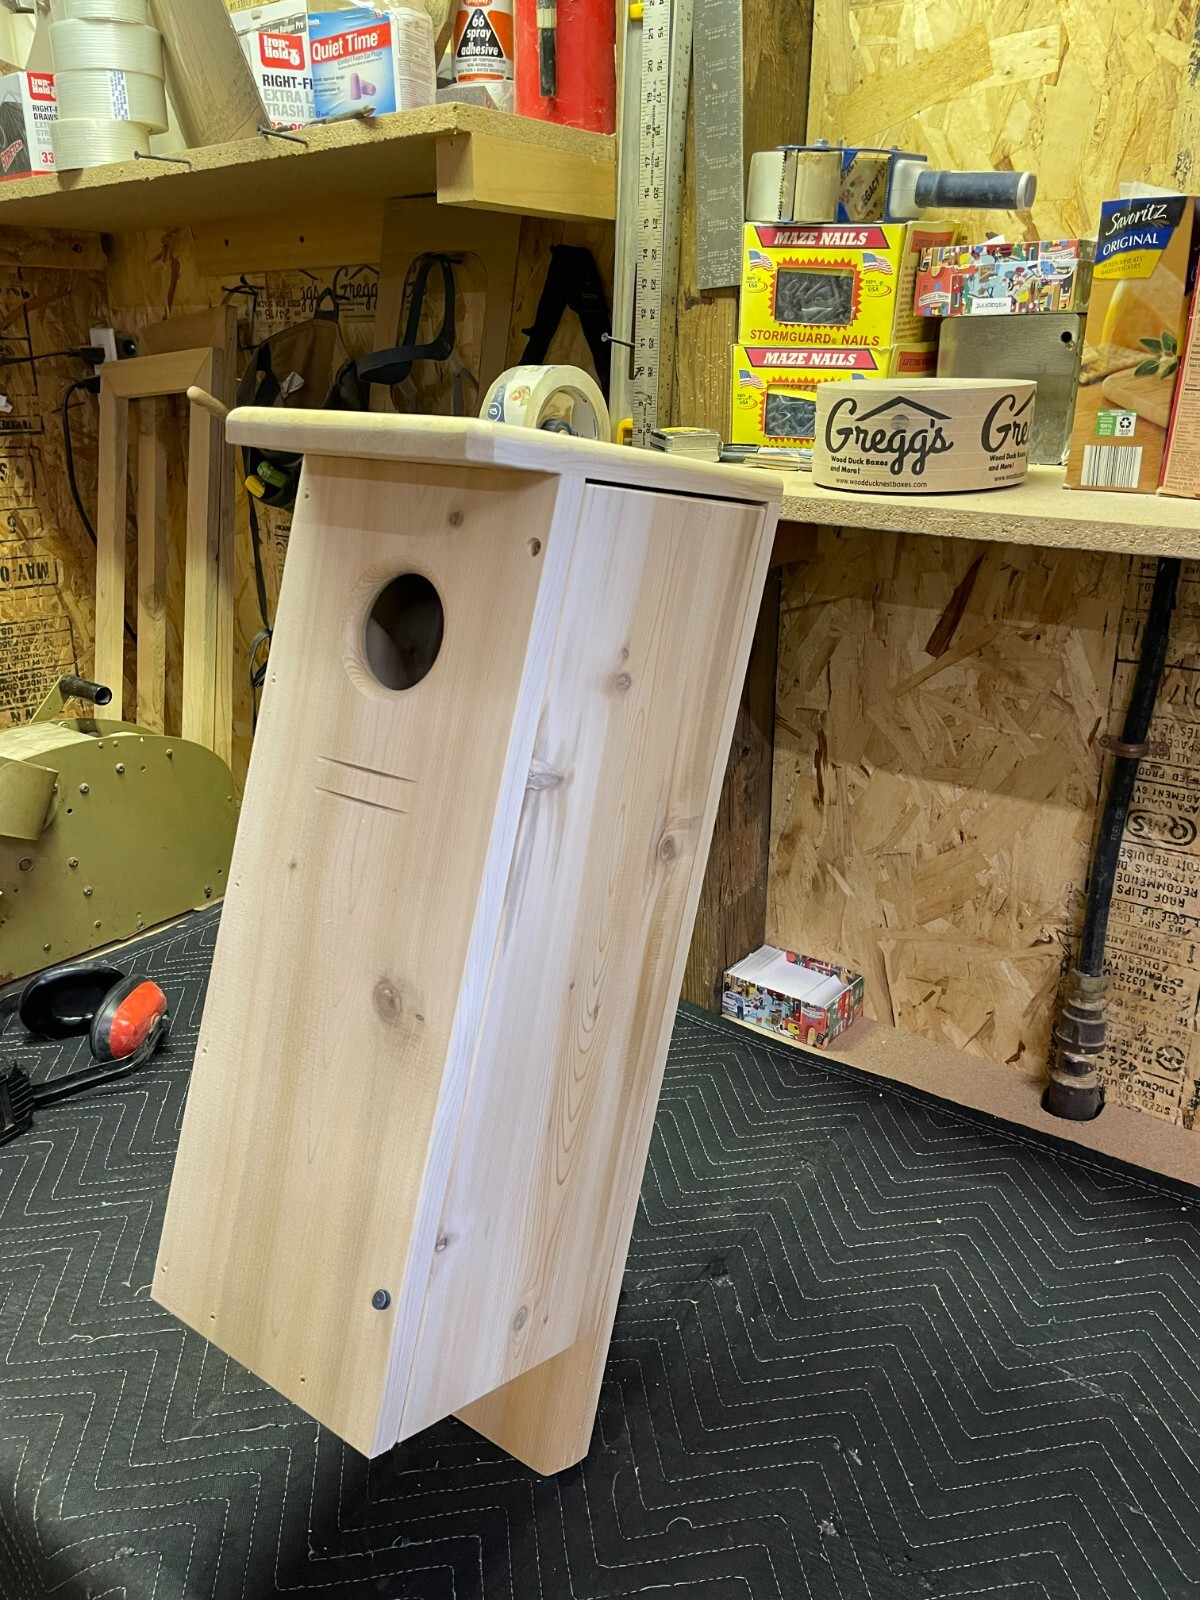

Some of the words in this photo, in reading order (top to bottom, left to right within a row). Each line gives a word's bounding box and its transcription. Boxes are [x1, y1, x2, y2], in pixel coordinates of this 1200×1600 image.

[472, 15, 485, 27] 66
[466, 29, 492, 41] spray
[648, 27, 654, 40] 21
[658, 26, 664, 38] 15
[263, 35, 290, 48] Iron-
[312, 38, 344, 61] Quiet
[346, 32, 378, 52] Time
[265, 46, 290, 60] Hold
[461, 42, 499, 55] adhesive
[647, 59, 653, 72] 20
[657, 59, 662, 71] 16
[264, 88, 302, 104] EXTRA
[646, 92, 652, 104] 19
[656, 92, 662, 104] 17
[265, 102, 305, 118] TRASH
[646, 124, 652, 137] 18
[655, 124, 661, 136] 18
[41, 152, 55, 164] 33
[645, 156, 650, 168] 17
[654, 156, 660, 168] 19
[644, 187, 650, 199] 16
[653, 187, 659, 199] 20
[643, 218, 649, 230] 15
[652, 218, 658, 229] 21
[1105, 204, 1168, 236] Savoritz
[774, 232, 819, 245] MAZE
[819, 232, 869, 246] NAILS
[1103, 232, 1159, 256] ORIGINAL
[642, 248, 648, 260] 14
[651, 248, 657, 260] 22
[641, 278, 647, 290] 13
[650, 278, 656, 291] 23
[640, 308, 646, 319] 12
[650, 308, 655, 320] 24
[640, 338, 646, 348] 11
[648, 338, 654, 349] 25
[841, 334, 880, 346] NAILS
[763, 352, 808, 365] MAZE
[809, 353, 858, 366] NAILS
[647, 366, 653, 378] 26
[646, 395, 652, 406] 27
[825, 398, 954, 475] Gregg's
[831, 455, 847, 464] Wood
[848, 456, 864, 465] Duck
[865, 458, 888, 466] Boxes
[830, 465, 840, 473] and
[841, 466, 861, 474] More!
[836, 477, 928, 488] www.woodducknestboxes.com
[1117, 885, 1149, 900] CLIPS
[1153, 893, 1186, 909] ROOF
[1153, 982, 1177, 997] CSA
[1141, 1099, 1171, 1116] SIZED
